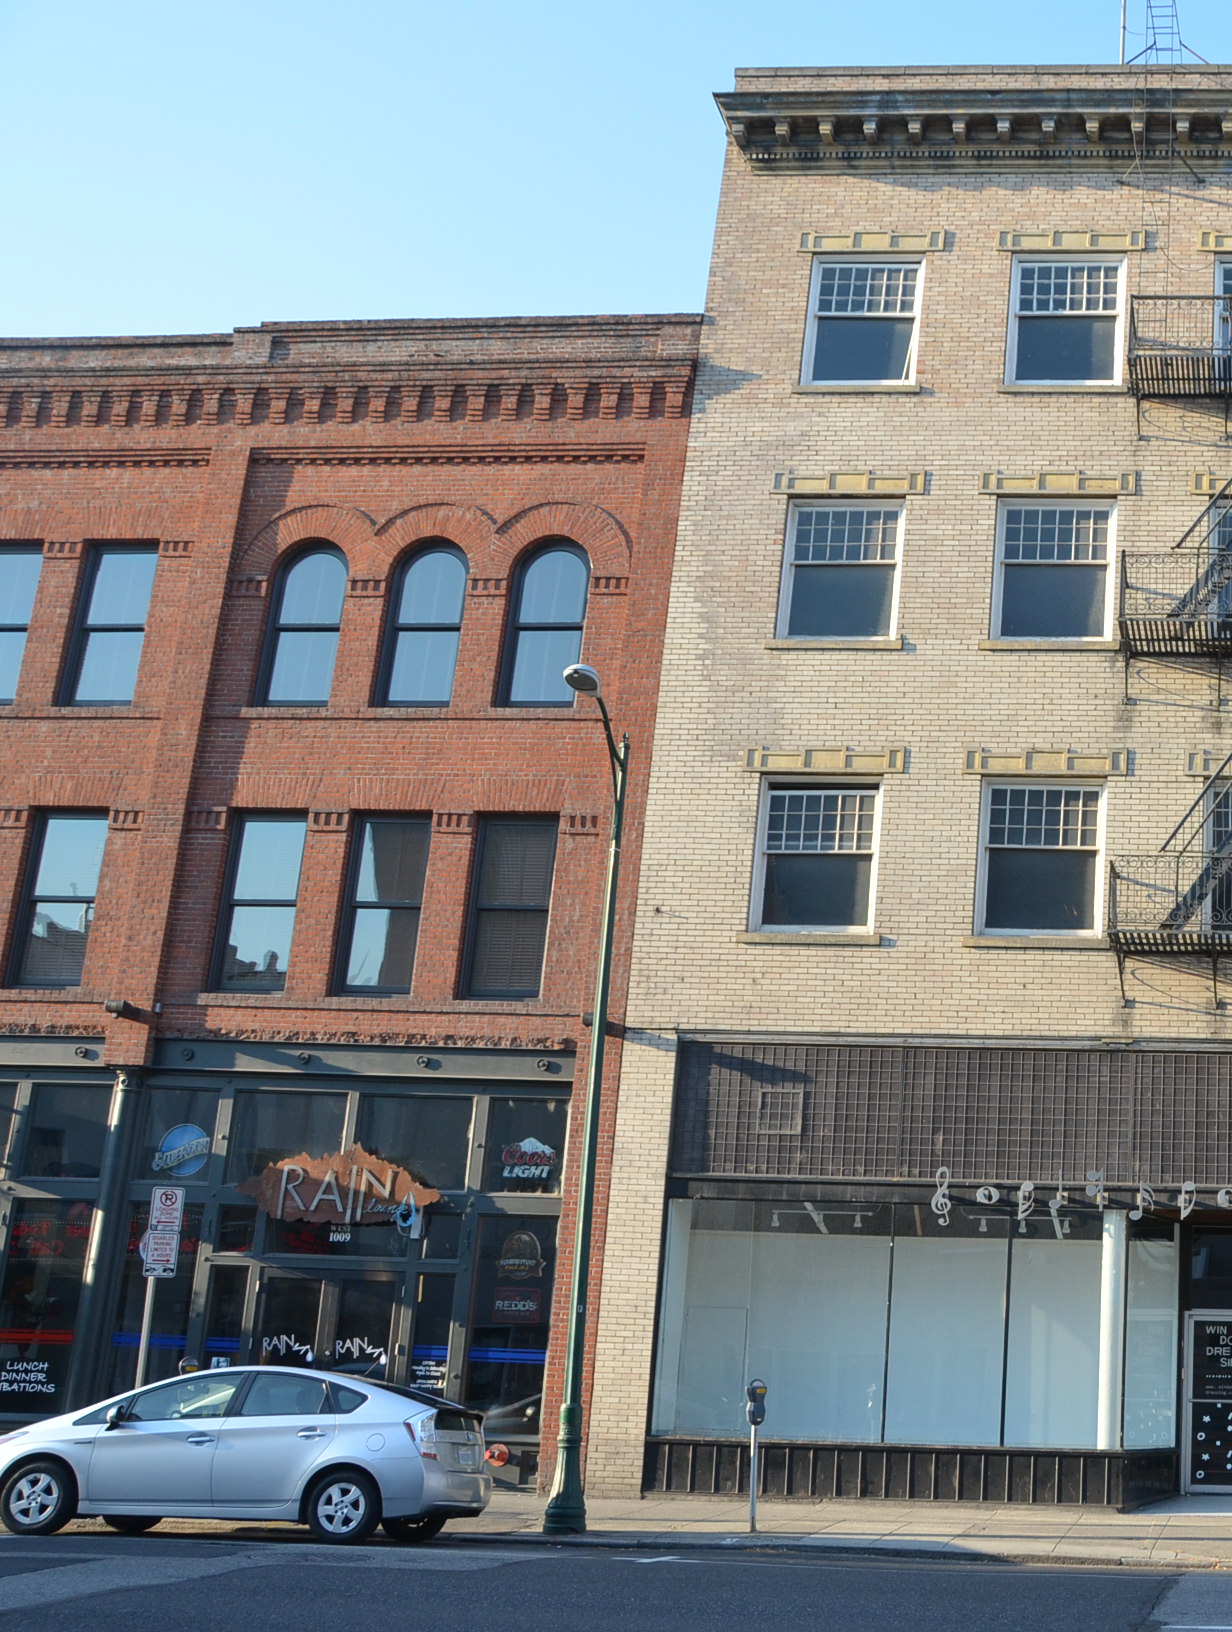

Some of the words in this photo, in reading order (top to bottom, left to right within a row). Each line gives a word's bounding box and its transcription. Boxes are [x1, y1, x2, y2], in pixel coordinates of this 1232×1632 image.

[502, 1142, 556, 1165] Coors
[502, 1165, 551, 1178] LIGHT
[277, 1164, 392, 1224] RAIN
[328, 1232, 351, 1242] 1009
[495, 1300, 537, 1311] REDD'S
[1205, 1325, 1228, 1335] WIN
[262, 1333, 295, 1357] RAIN
[335, 1336, 368, 1359] RAIN
[6, 1361, 49, 1371] LUNCH
[0, 1371, 48, 1381] DINNER
